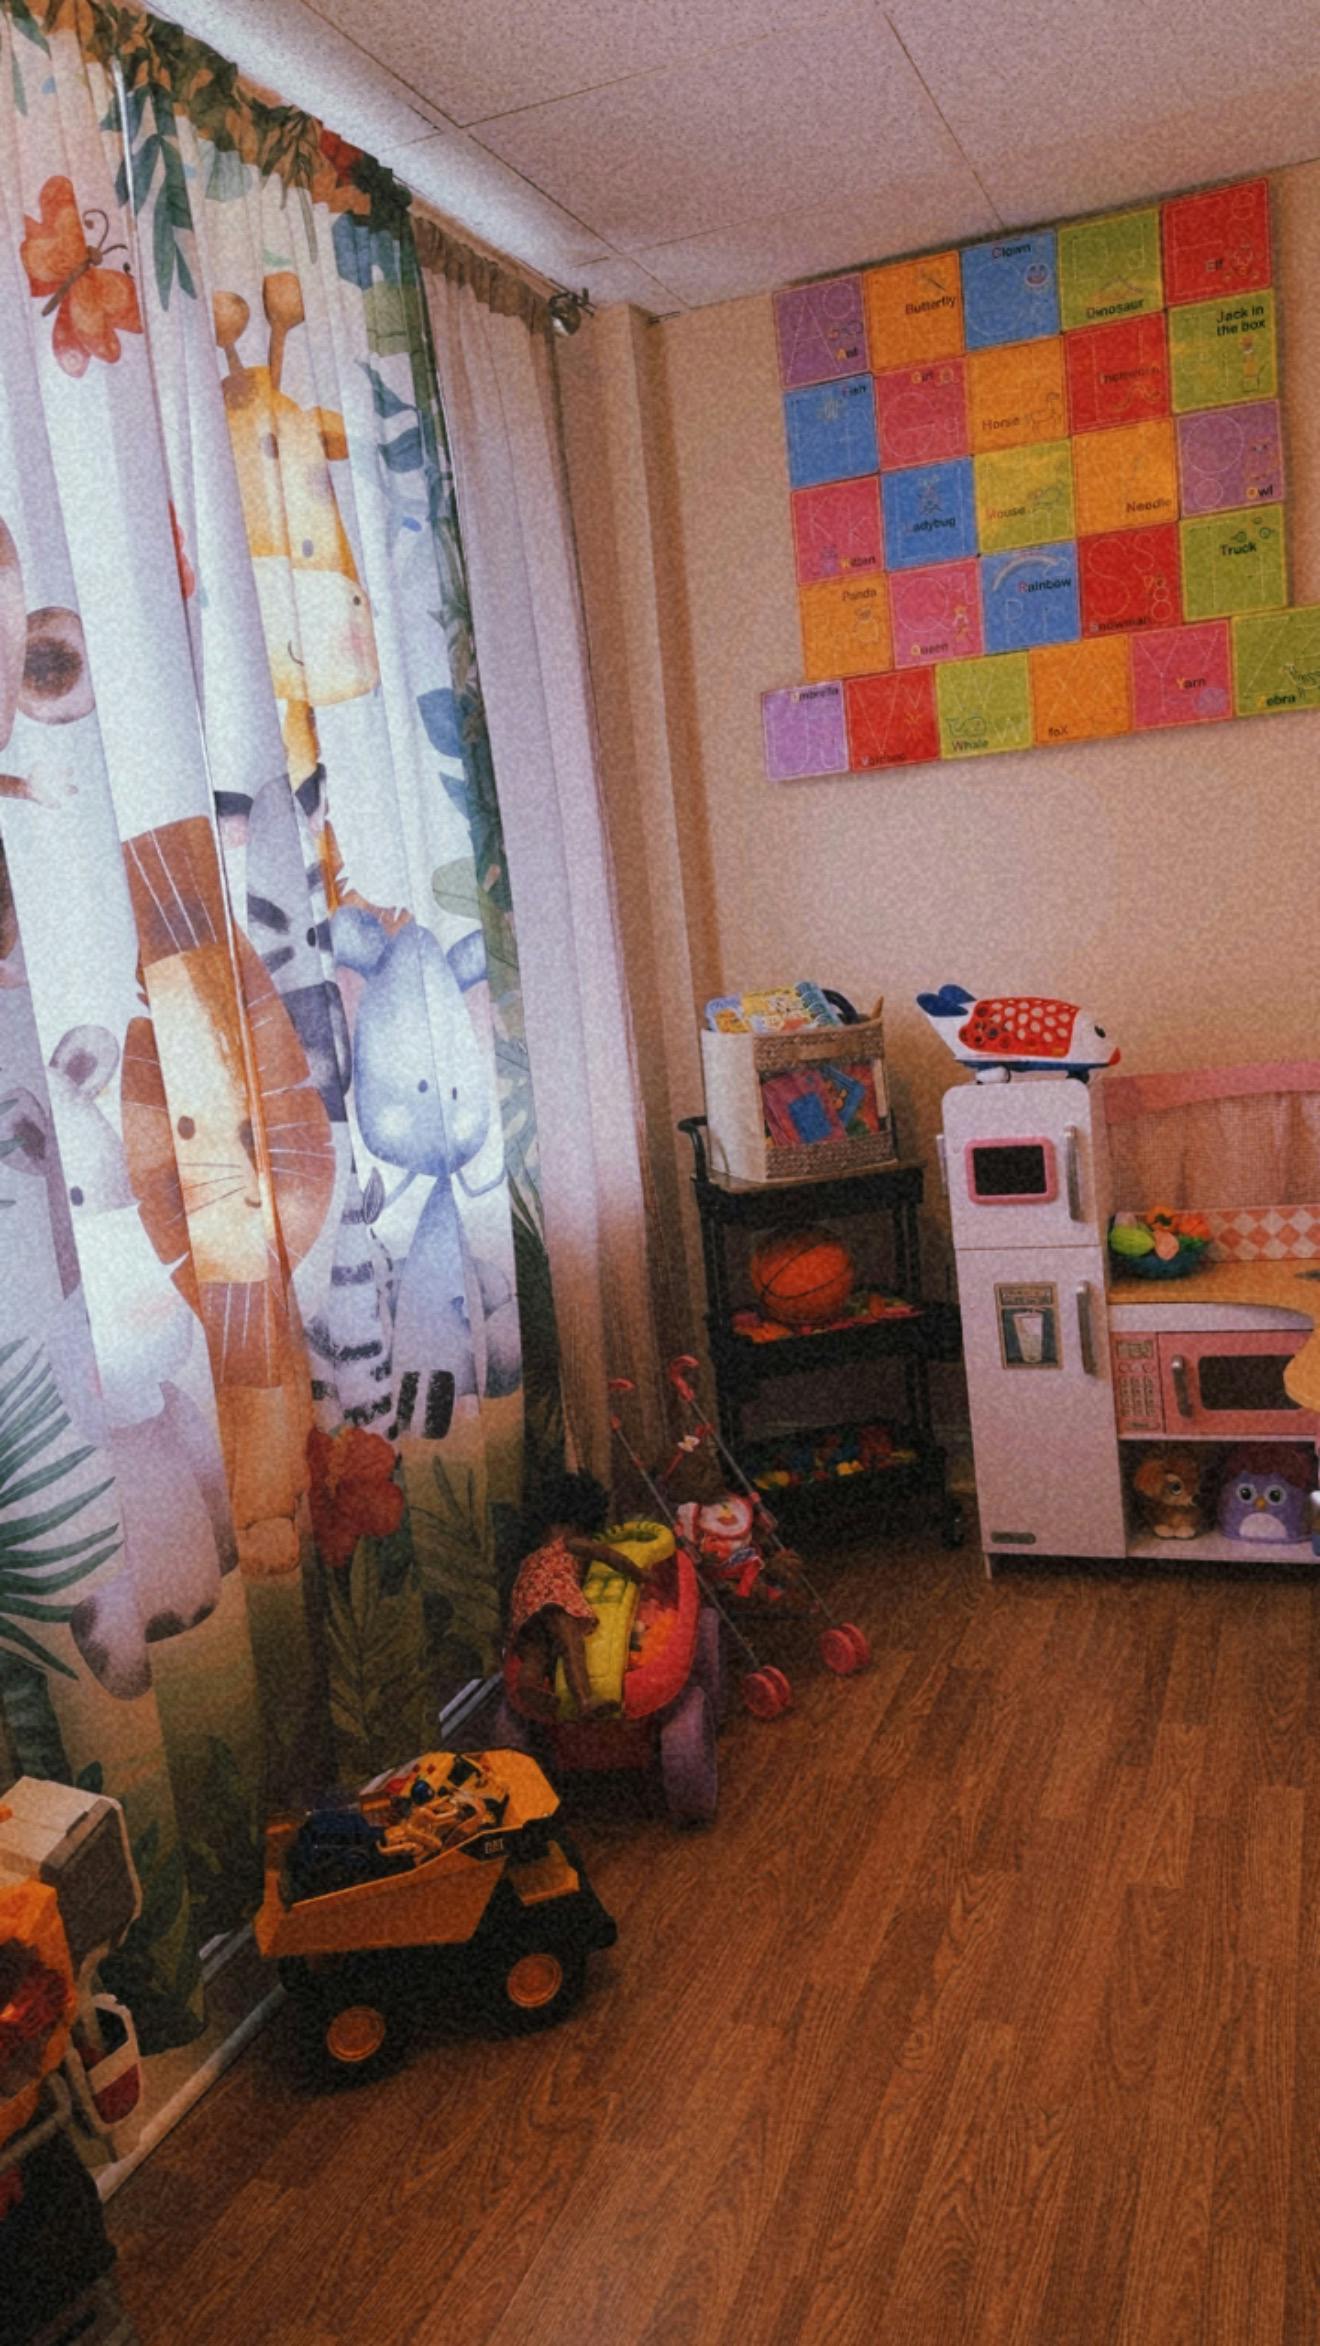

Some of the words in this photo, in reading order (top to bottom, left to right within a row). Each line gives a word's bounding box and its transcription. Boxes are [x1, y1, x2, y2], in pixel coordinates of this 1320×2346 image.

[991, 243, 1032, 260] Clown
[1204, 258, 1225, 273] Elf
[905, 295, 956, 315] Butterfly
[1085, 298, 1145, 320] Dinosaur
[1217, 306, 1248, 324] Jack
[1251, 303, 1265, 318] in
[1216, 321, 1239, 337] the
[1241, 318, 1267, 334] box
[982, 415, 1021, 432] Horse
[1245, 483, 1275, 500] Owl
[986, 504, 1027, 521] Mouse
[1125, 496, 1172, 514] Needle
[904, 516, 957, 534] Ladybug
[1220, 541, 1258, 558] Truck
[1017, 576, 1072, 593] Rainbow
[1088, 538, 1132, 618] S
[842, 586, 878, 603] Panda
[897, 576, 952, 634] Q
[910, 643, 949, 657] Queen
[1137, 630, 1182, 716] Y
[1176, 676, 1207, 690] Yarn
[791, 687, 840, 704] Umbrella
[1256, 691, 1298, 709] Zebra
[854, 675, 901, 757] V
[951, 738, 989, 752] Whale
